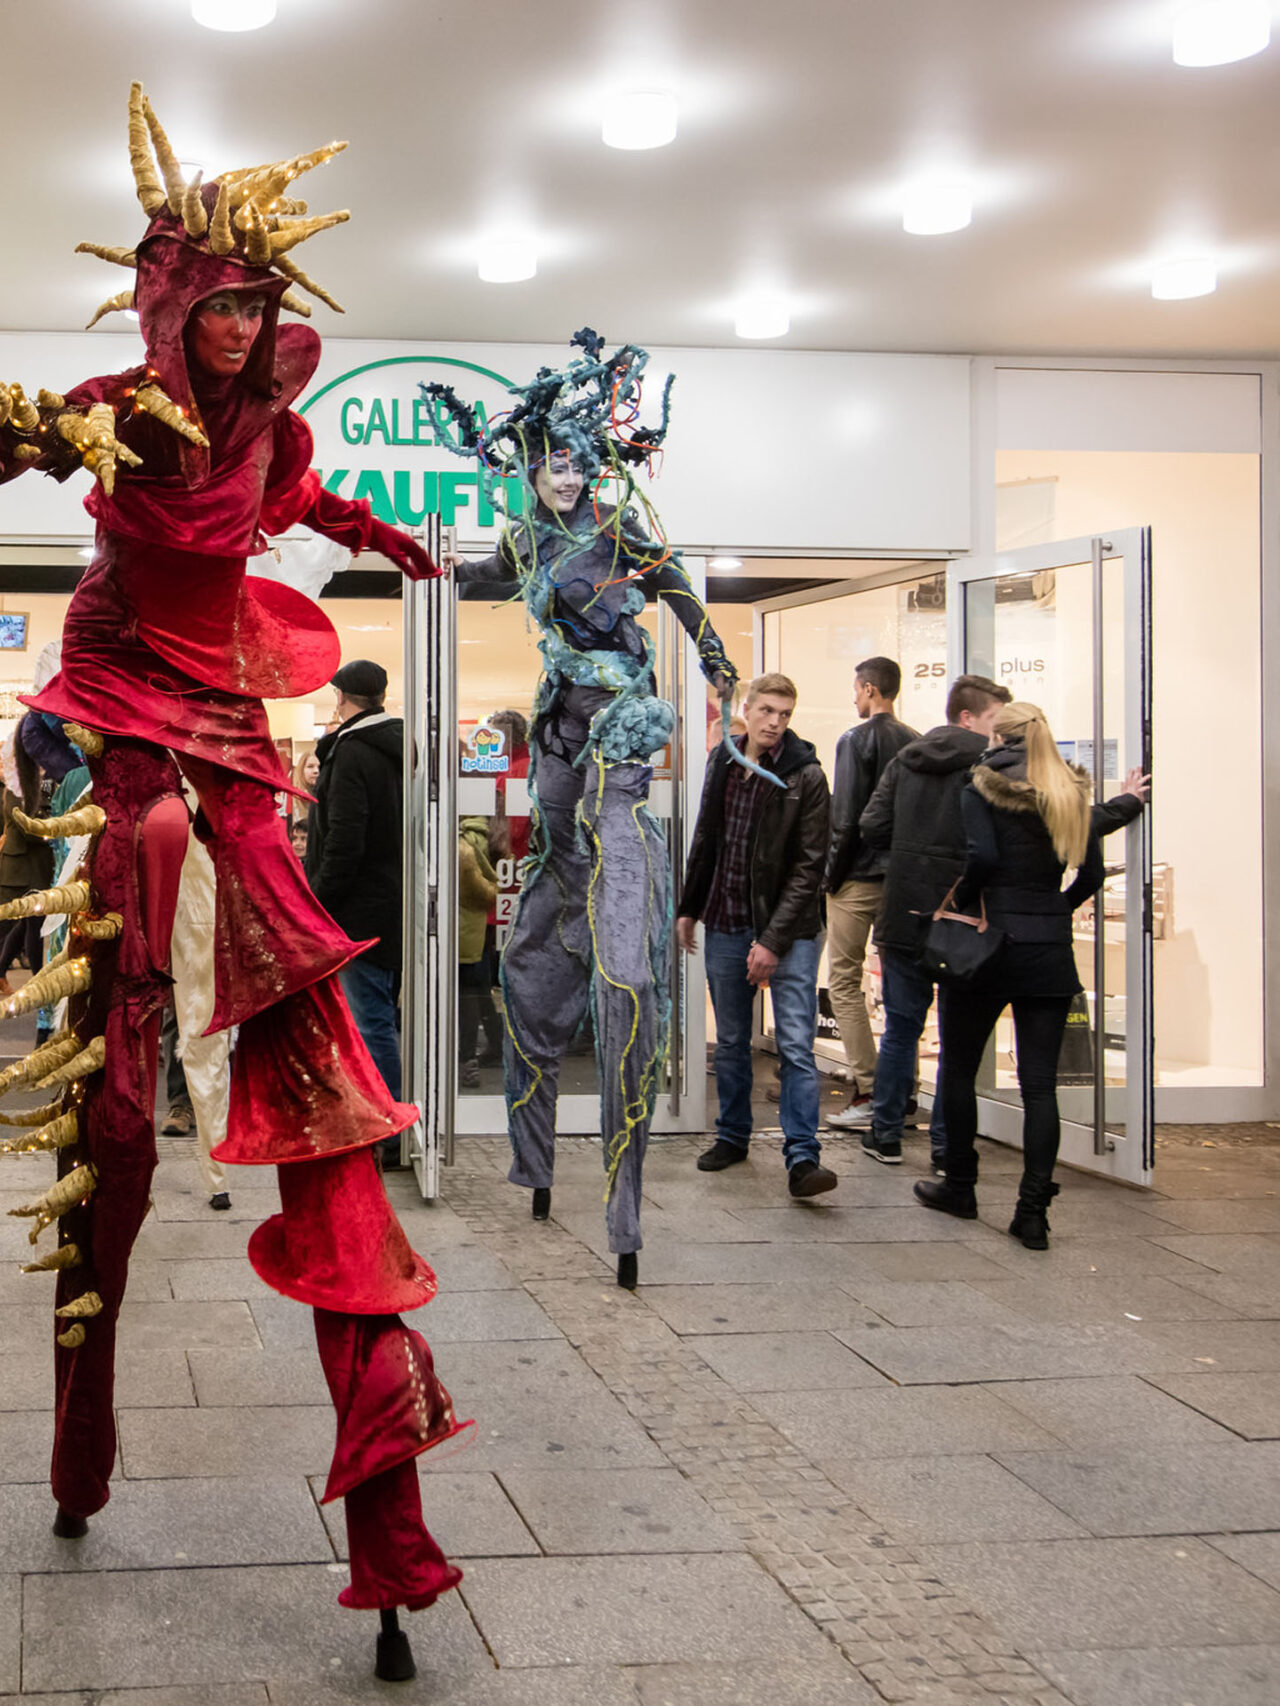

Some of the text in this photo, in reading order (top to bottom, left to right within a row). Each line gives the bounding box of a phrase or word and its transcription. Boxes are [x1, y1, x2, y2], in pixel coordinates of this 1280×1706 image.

[340, 397, 491, 446] GALERA
[1000, 657, 1045, 677] plus
[463, 757, 508, 770] notinsel
